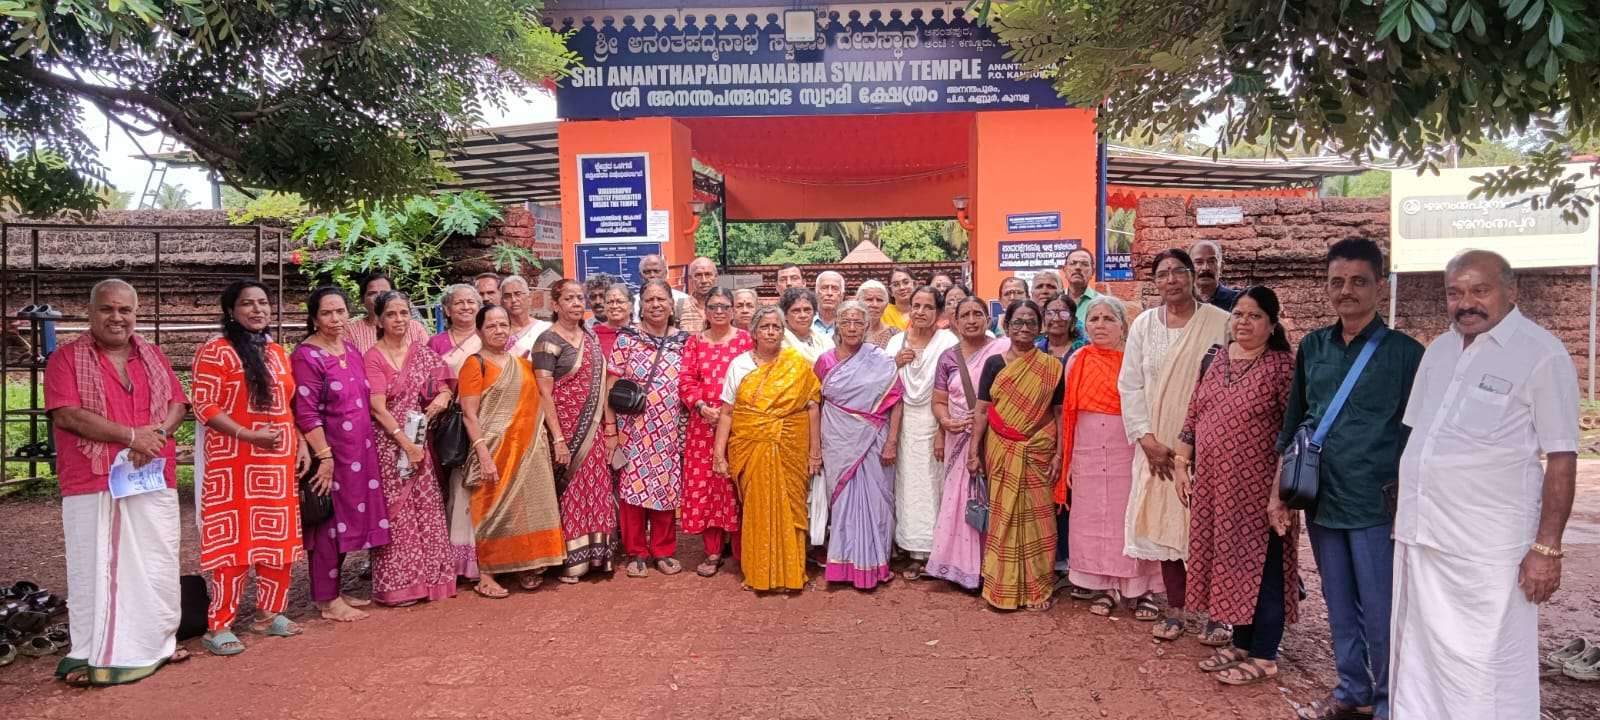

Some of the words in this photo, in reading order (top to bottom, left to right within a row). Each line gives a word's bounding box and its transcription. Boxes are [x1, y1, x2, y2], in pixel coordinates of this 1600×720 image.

[593, 32, 618, 62] ಶ್ರೀ
[836, 27, 919, 59] ದೇವಸ್ಥಾನ
[571, 66, 603, 87] SRI
[607, 62, 824, 86] ANANTHAPADMANABHA
[831, 60, 906, 83] SWAMY
[909, 59, 982, 80] TEMPLE
[988, 71, 1004, 79] P.O.
[611, 87, 640, 111] ശ്രീ
[799, 83, 852, 107] സ്വാമി
[859, 86, 938, 106] ക്ഷേത്രം
[1020, 252, 1036, 260] YOUR
